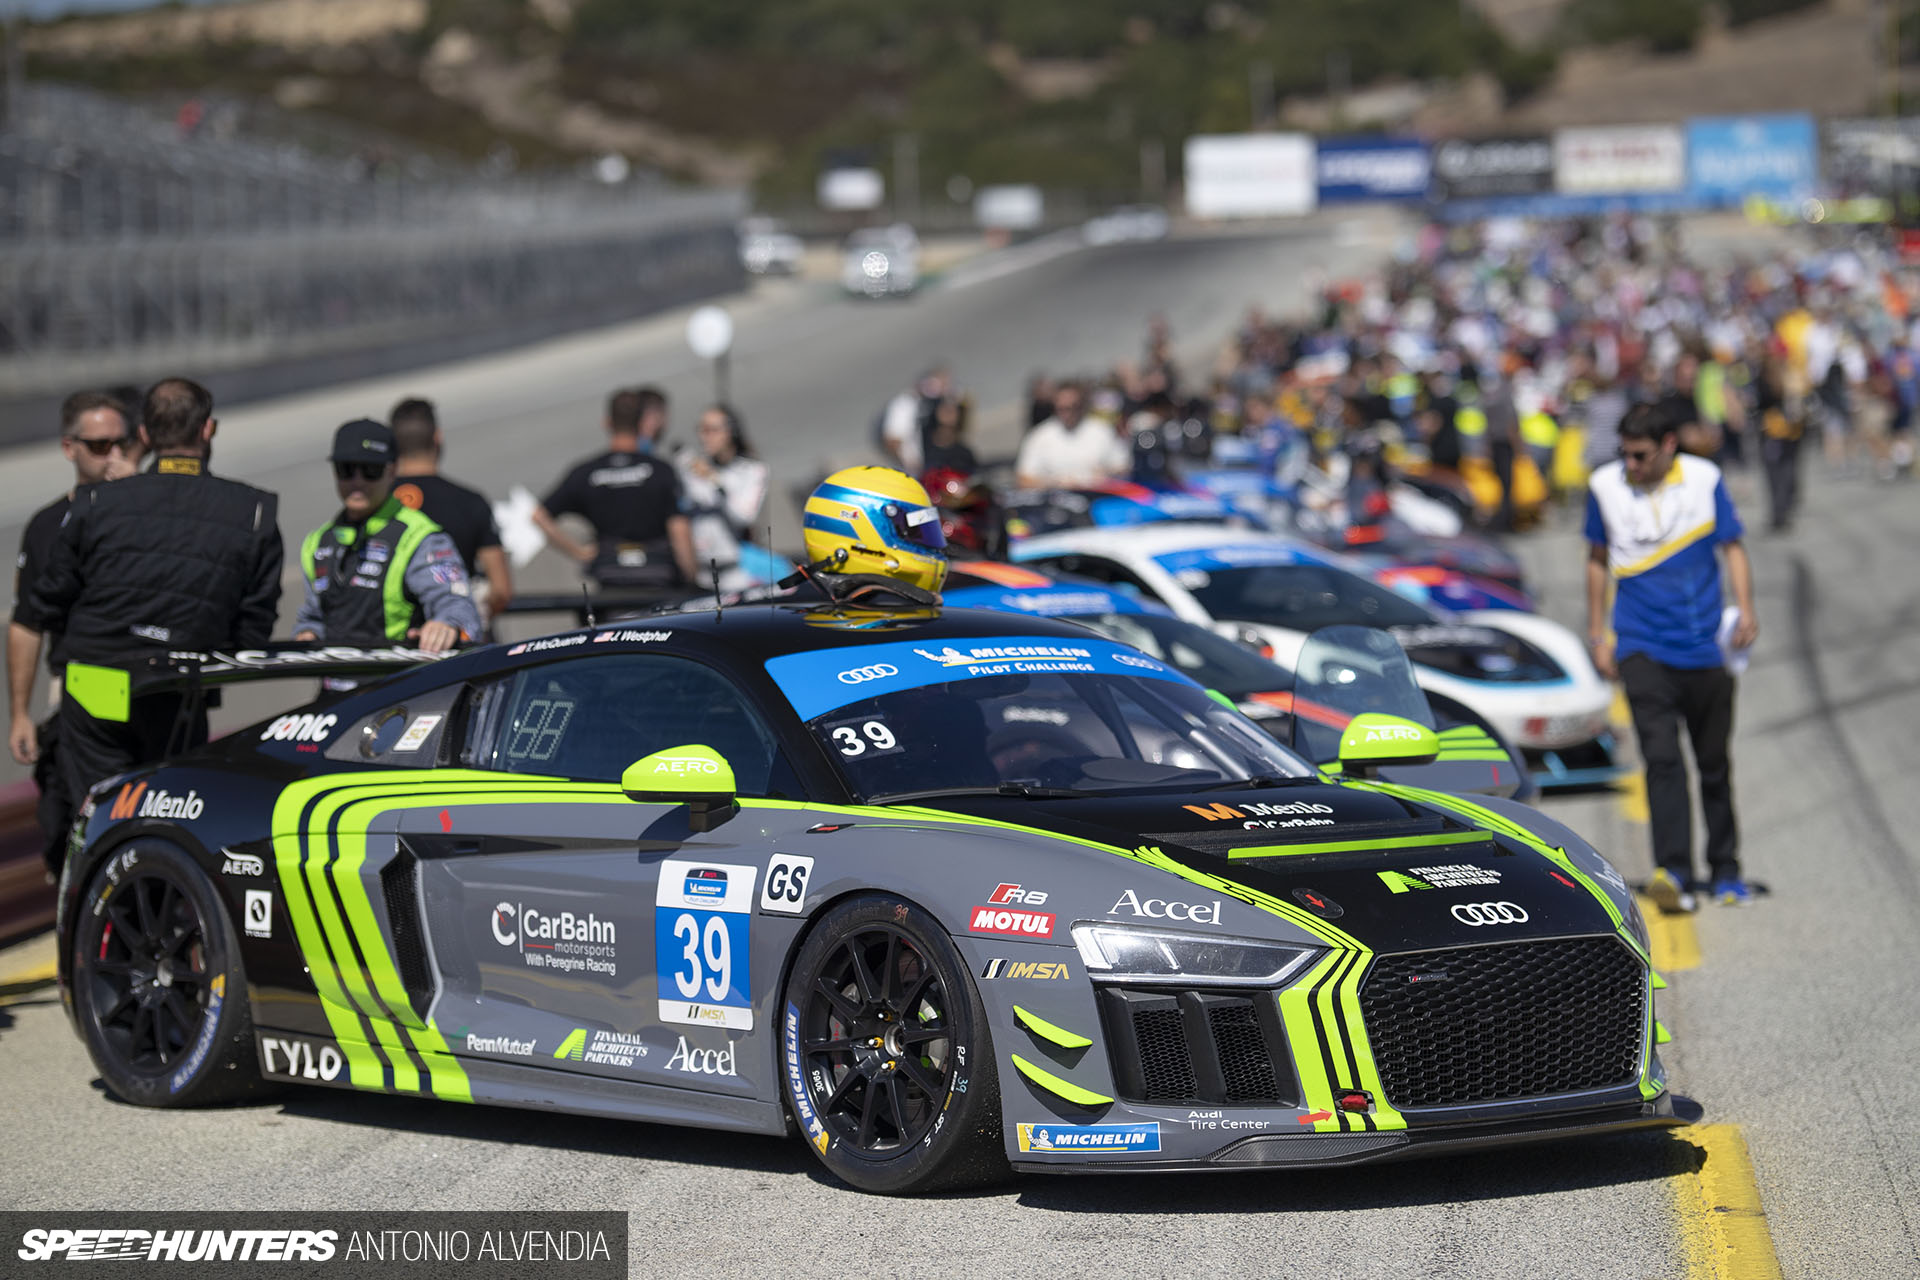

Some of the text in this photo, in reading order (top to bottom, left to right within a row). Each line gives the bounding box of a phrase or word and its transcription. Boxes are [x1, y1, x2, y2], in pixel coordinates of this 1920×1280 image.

[620, 630, 673, 643] Westphal
[970, 646, 1091, 658] MICHELIN
[831, 720, 898, 757] 39
[1365, 728, 1422, 742] AERO
[653, 761, 719, 774] AERO
[138, 789, 205, 820] Menlo
[1238, 801, 1334, 816] Menlo
[221, 859, 265, 877] AERO
[1408, 864, 1481, 875] FINANCIAL
[1422, 870, 1502, 882] ARCHITECTS
[767, 863, 807, 903] GS
[1431, 877, 1501, 888] PARTNERS
[1001, 887, 1049, 905] R8
[1106, 889, 1222, 925] Accel
[523, 908, 616, 944] CarBahn
[973, 909, 1050, 934] MOTUL
[554, 942, 616, 958] motorsports
[673, 913, 732, 1001] 39
[524, 952, 616, 976] With Peregrine Racing
[1006, 962, 1070, 980] IMSA
[700, 1007, 726, 1020] IMSA
[467, 1033, 537, 1056] PennMutual
[594, 1030, 642, 1045] FINANCIAL
[591, 1041, 649, 1057] ARCHITECTS
[663, 1035, 737, 1076] Accel
[584, 1051, 634, 1067] PARTNERS
[788, 1012, 812, 1119] MICHELIN
[956, 1076, 969, 1094] 39
[1188, 1110, 1223, 1119] Audi
[1188, 1119, 1270, 1130] Tire Center
[1054, 1132, 1147, 1146] MICHELIN
